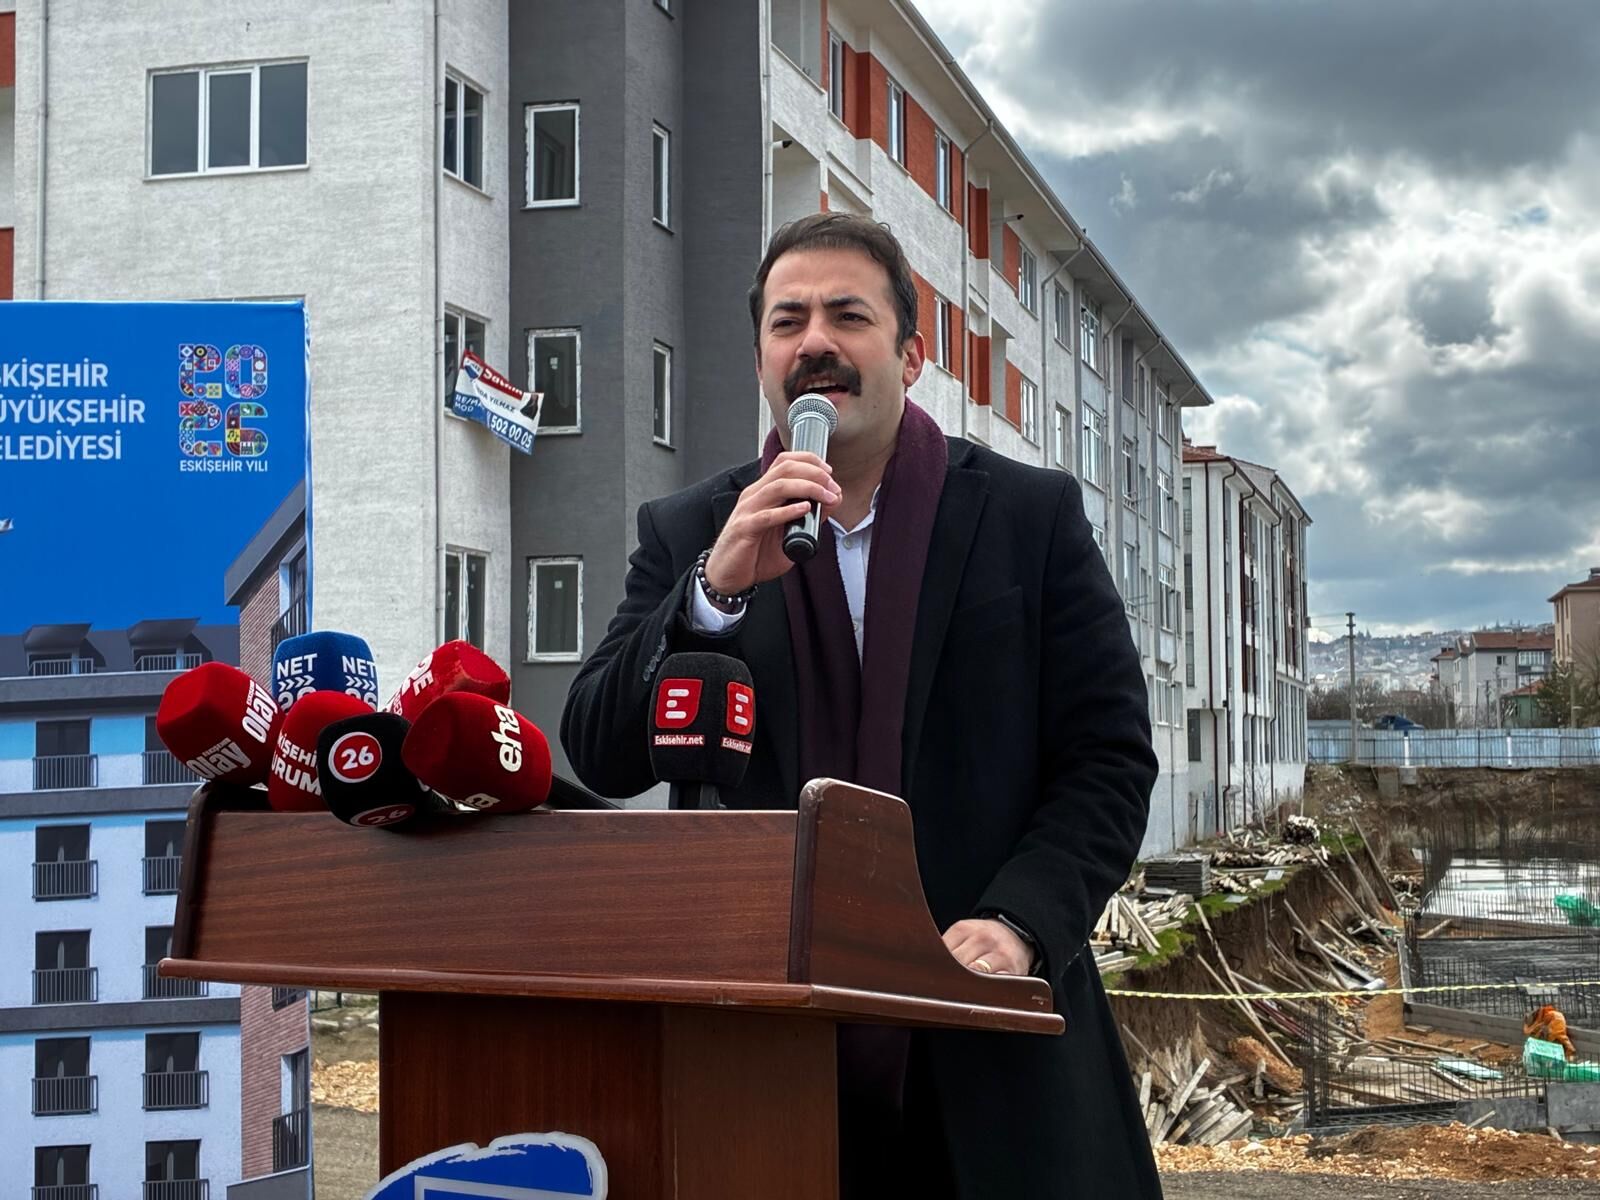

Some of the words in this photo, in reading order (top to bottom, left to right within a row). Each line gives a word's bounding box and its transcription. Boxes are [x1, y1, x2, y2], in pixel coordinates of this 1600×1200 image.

[0, 357, 109, 391] KİŞEHİR
[0, 429, 122, 460] LEDİYESİ
[491, 415, 508, 435] 502
[509, 424, 522, 441] 00
[521, 431, 532, 448] 05
[180, 457, 243, 473] ESKİŞEHİR
[246, 459, 269, 472] YILI
[277, 653, 318, 680] NET
[341, 655, 377, 678] NET
[242, 682, 278, 744] Olay
[491, 704, 522, 773] eha
[186, 741, 252, 779] Olay
[341, 745, 375, 771] 26
